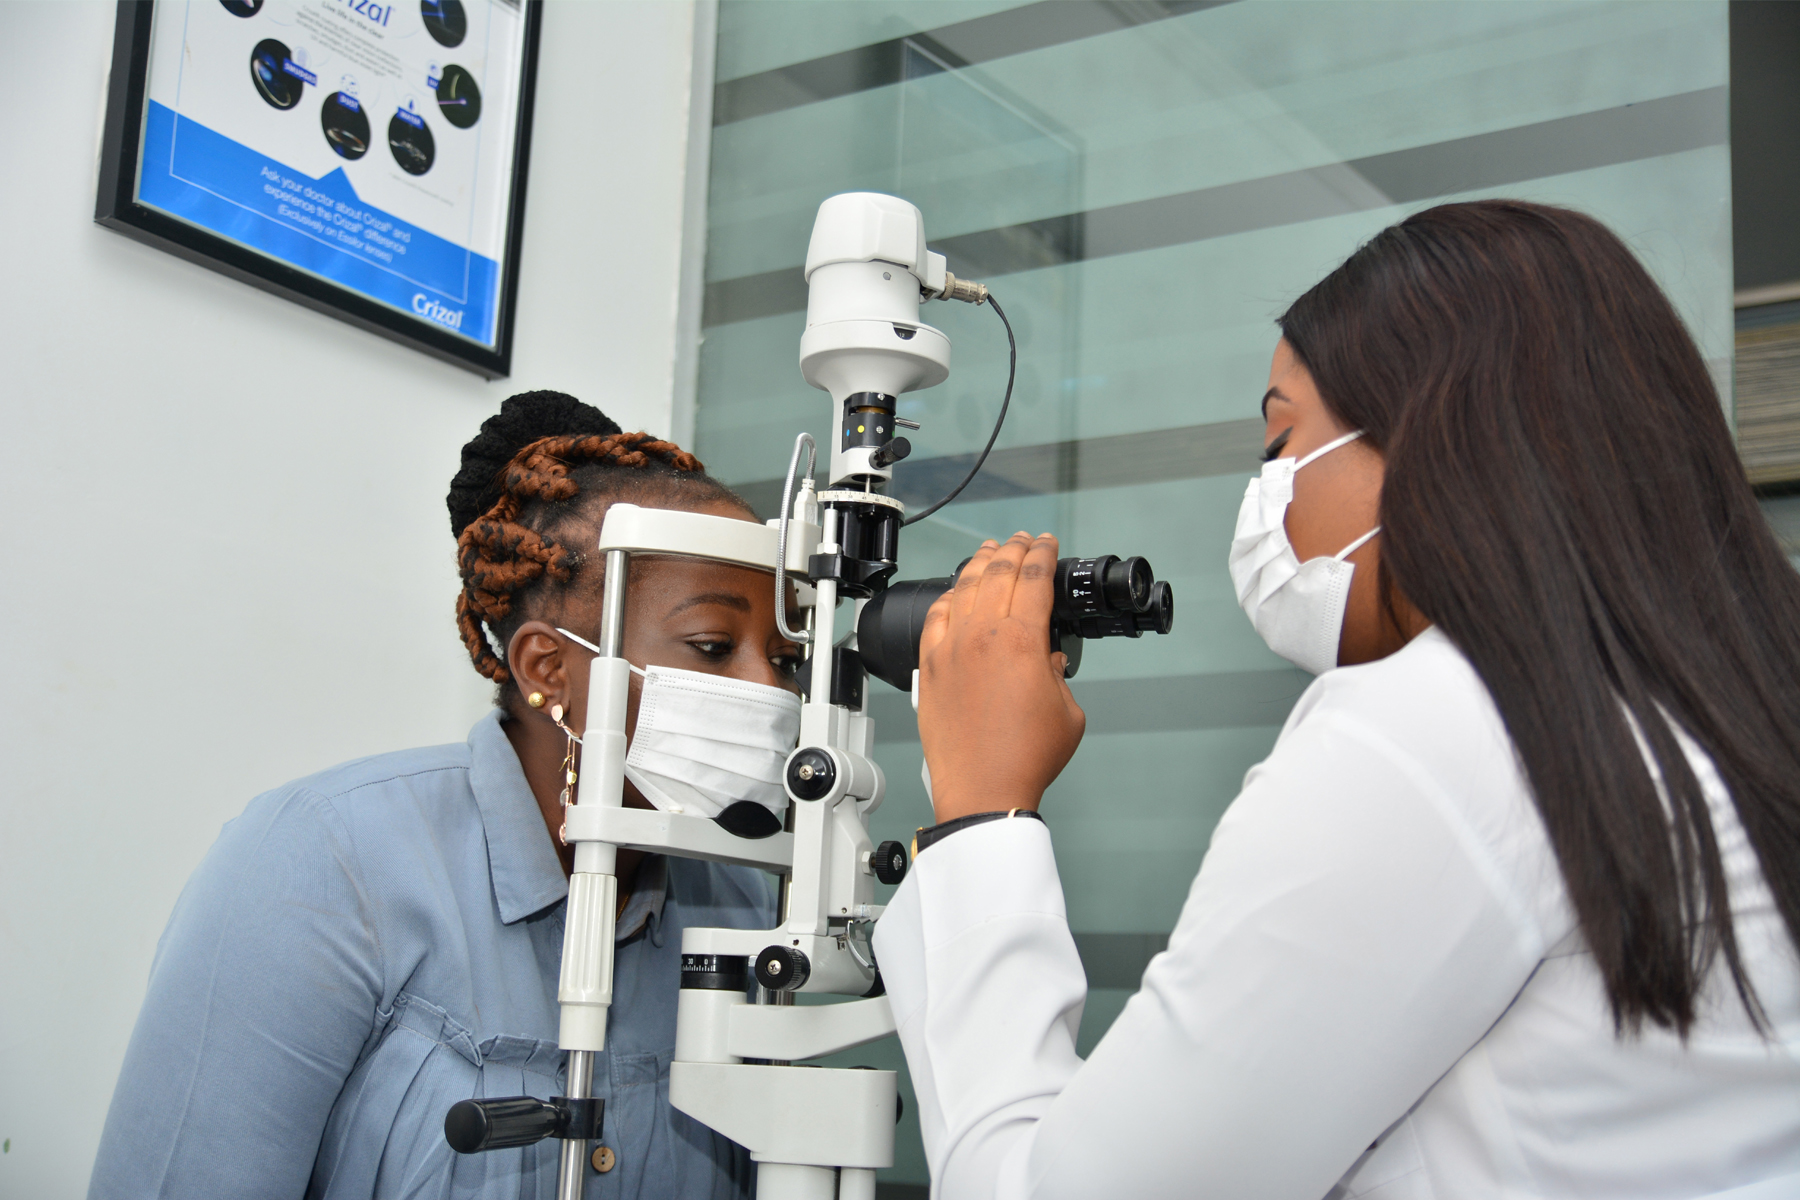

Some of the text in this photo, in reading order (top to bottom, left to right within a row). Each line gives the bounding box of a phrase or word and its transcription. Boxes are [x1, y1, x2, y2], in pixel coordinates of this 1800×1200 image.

[337, 9, 347, 19] life
[356, 21, 367, 31] the
[368, 28, 384, 39] clear
[340, 95, 359, 110] DUST
[260, 166, 281, 183] Ask
[281, 177, 303, 193] your
[303, 187, 335, 207] doctor
[335, 202, 362, 221] about
[392, 228, 411, 243] and
[263, 184, 316, 214] experience
[316, 206, 332, 221] the
[363, 229, 406, 255] difference
[277, 204, 393, 264] (Exclusively on Essilor lenses)
[412, 293, 463, 328] Crizal
